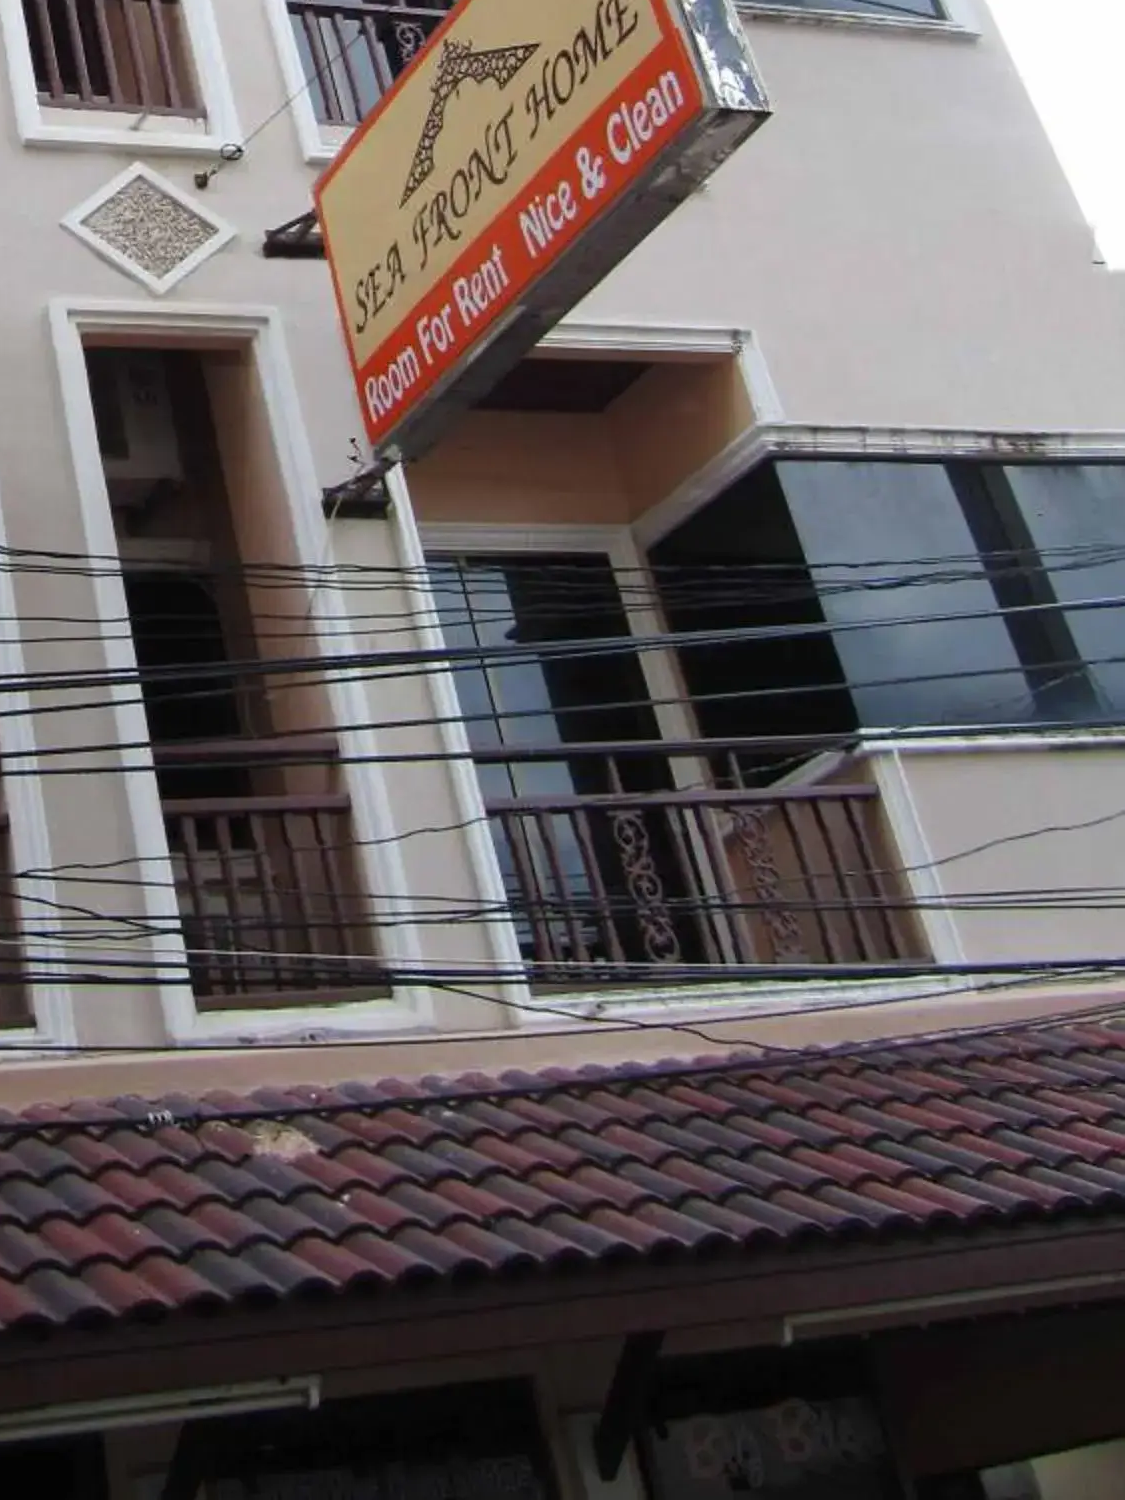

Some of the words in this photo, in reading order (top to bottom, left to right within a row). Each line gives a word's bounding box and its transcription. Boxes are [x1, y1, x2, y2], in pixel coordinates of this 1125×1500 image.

[355, 240, 407, 334] SEA
[412, 104, 517, 271] FRONT
[364, 345, 421, 424] Room
[416, 303, 455, 366] For
[452, 242, 511, 327] Rent
[518, 180, 578, 259] Nice
[576, 146, 607, 200] &
[606, 70, 684, 166] Clean
